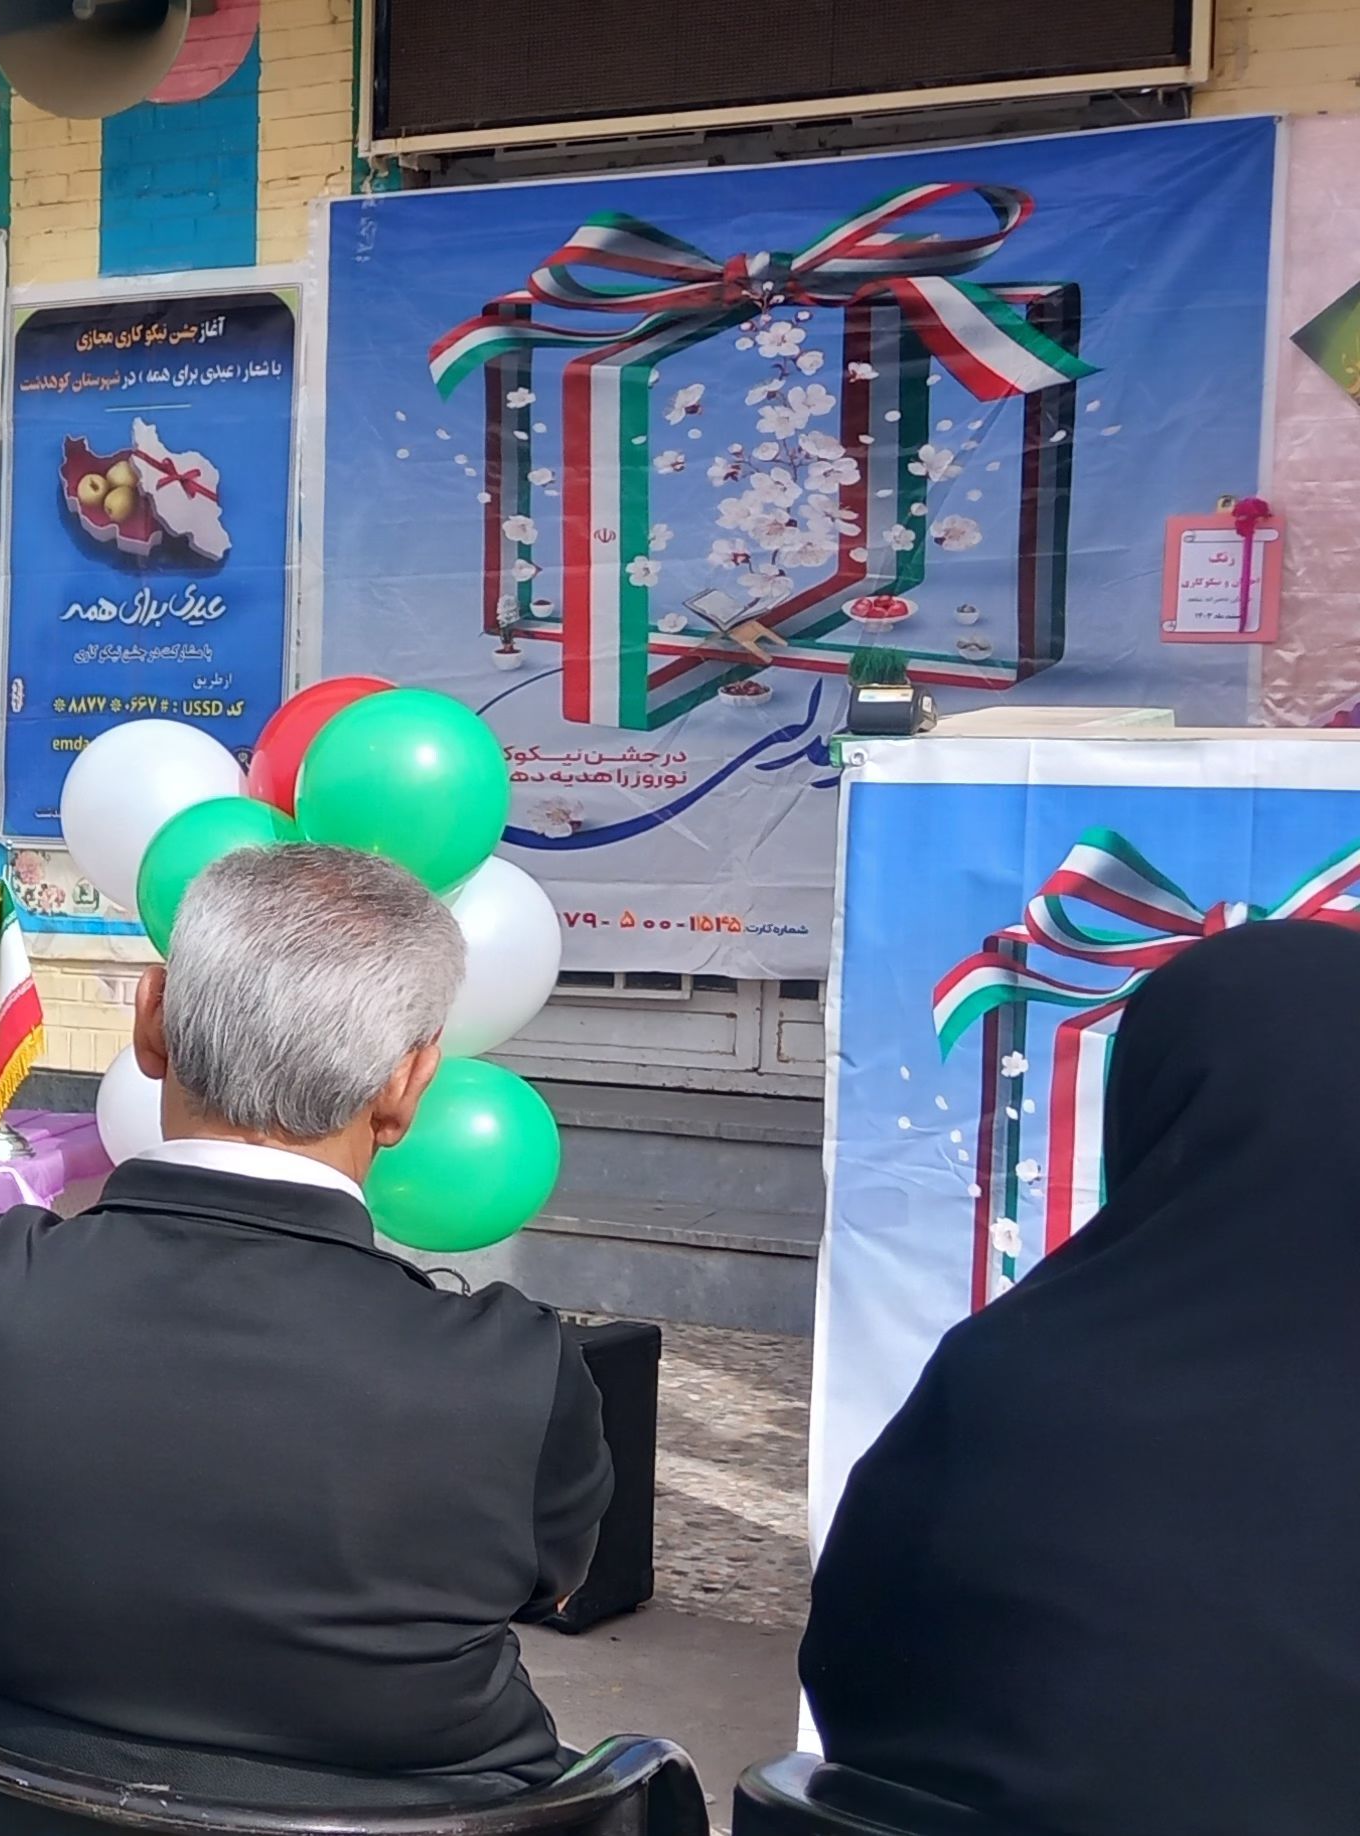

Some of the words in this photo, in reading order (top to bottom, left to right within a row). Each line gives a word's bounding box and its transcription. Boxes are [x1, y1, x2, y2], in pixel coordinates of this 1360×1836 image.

[76, 328, 114, 352] مجازی
[169, 324, 199, 345] جشن
[198, 316, 226, 343] آغاز
[121, 371, 137, 390] در
[172, 362, 199, 388] برای
[60, 597, 118, 622] همه
[118, 587, 170, 627] برای
[169, 583, 227, 626] عیدی
[182, 699, 223, 717] USSD
[584, 746, 661, 768] جشن
[660, 750, 687, 767] در
[549, 770, 613, 788] هدیه
[630, 771, 687, 789] نوروز
